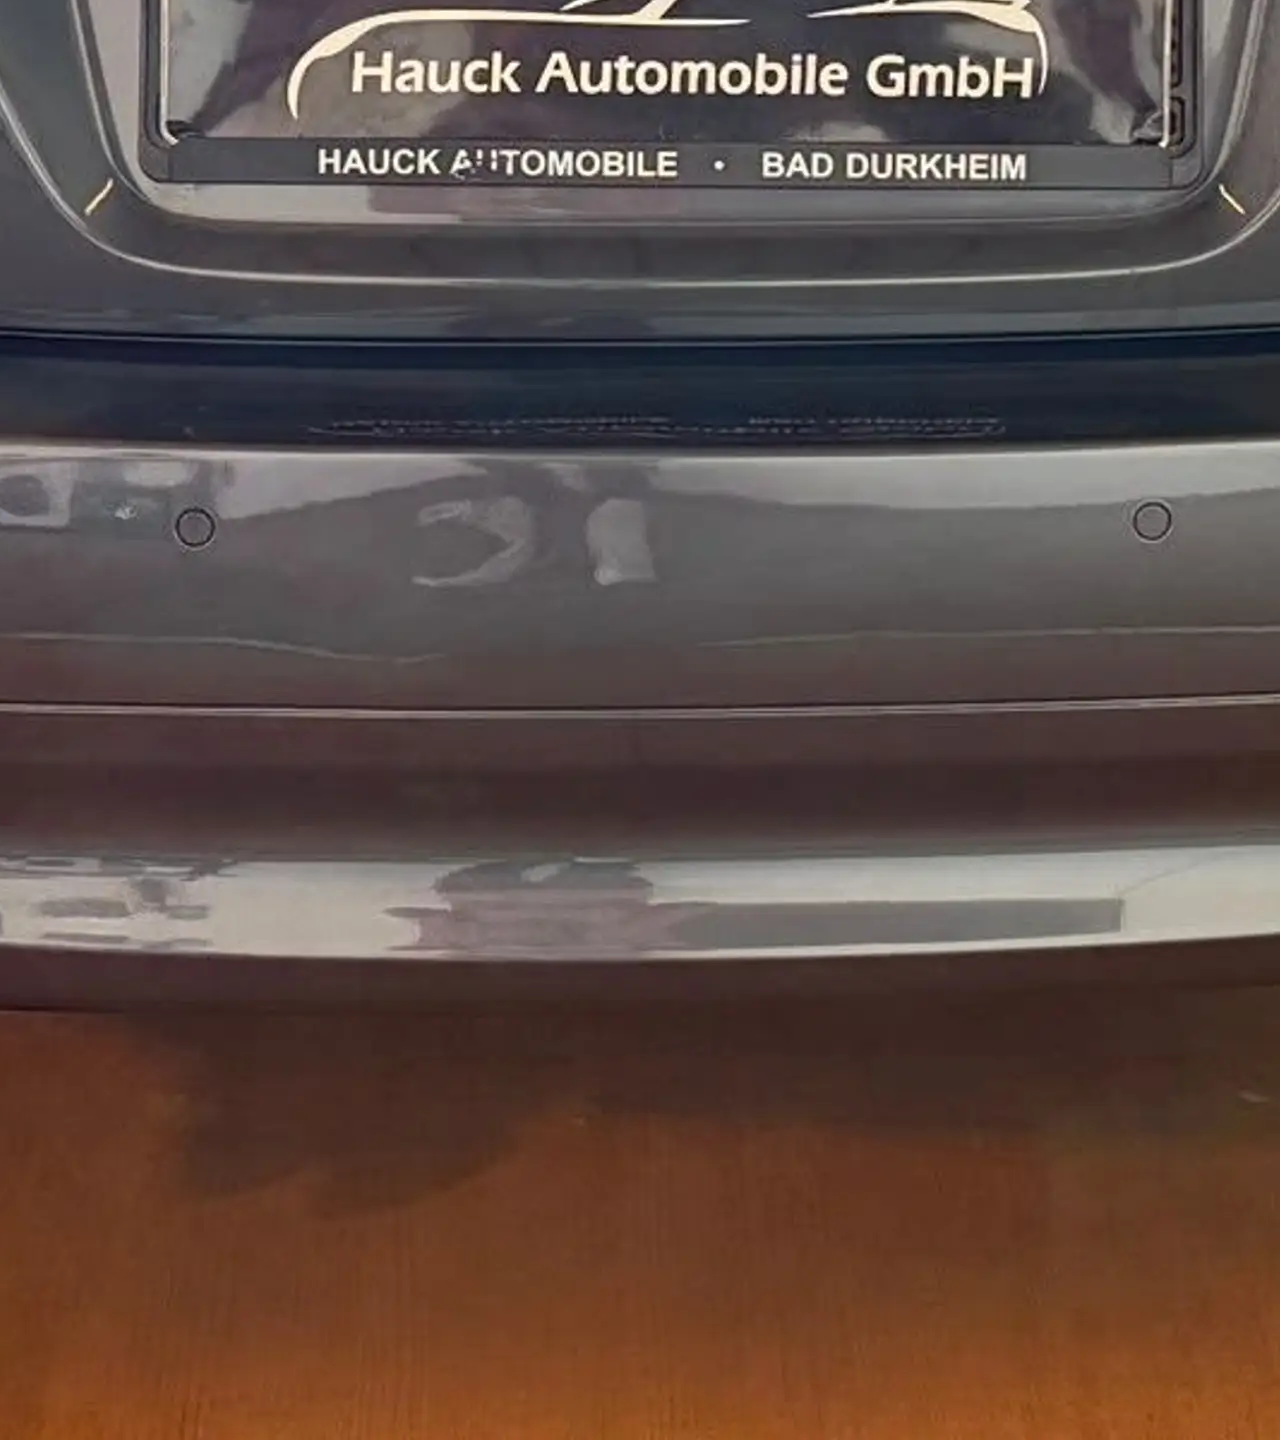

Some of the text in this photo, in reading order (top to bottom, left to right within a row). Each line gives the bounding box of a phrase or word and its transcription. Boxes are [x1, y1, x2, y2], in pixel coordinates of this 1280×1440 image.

[351, 50, 1034, 99] Hauck Automobile GmbH
[318, 148, 442, 176] HAUCK
[761, 151, 834, 179] BAD
[845, 153, 1027, 181] DURKHEIM
